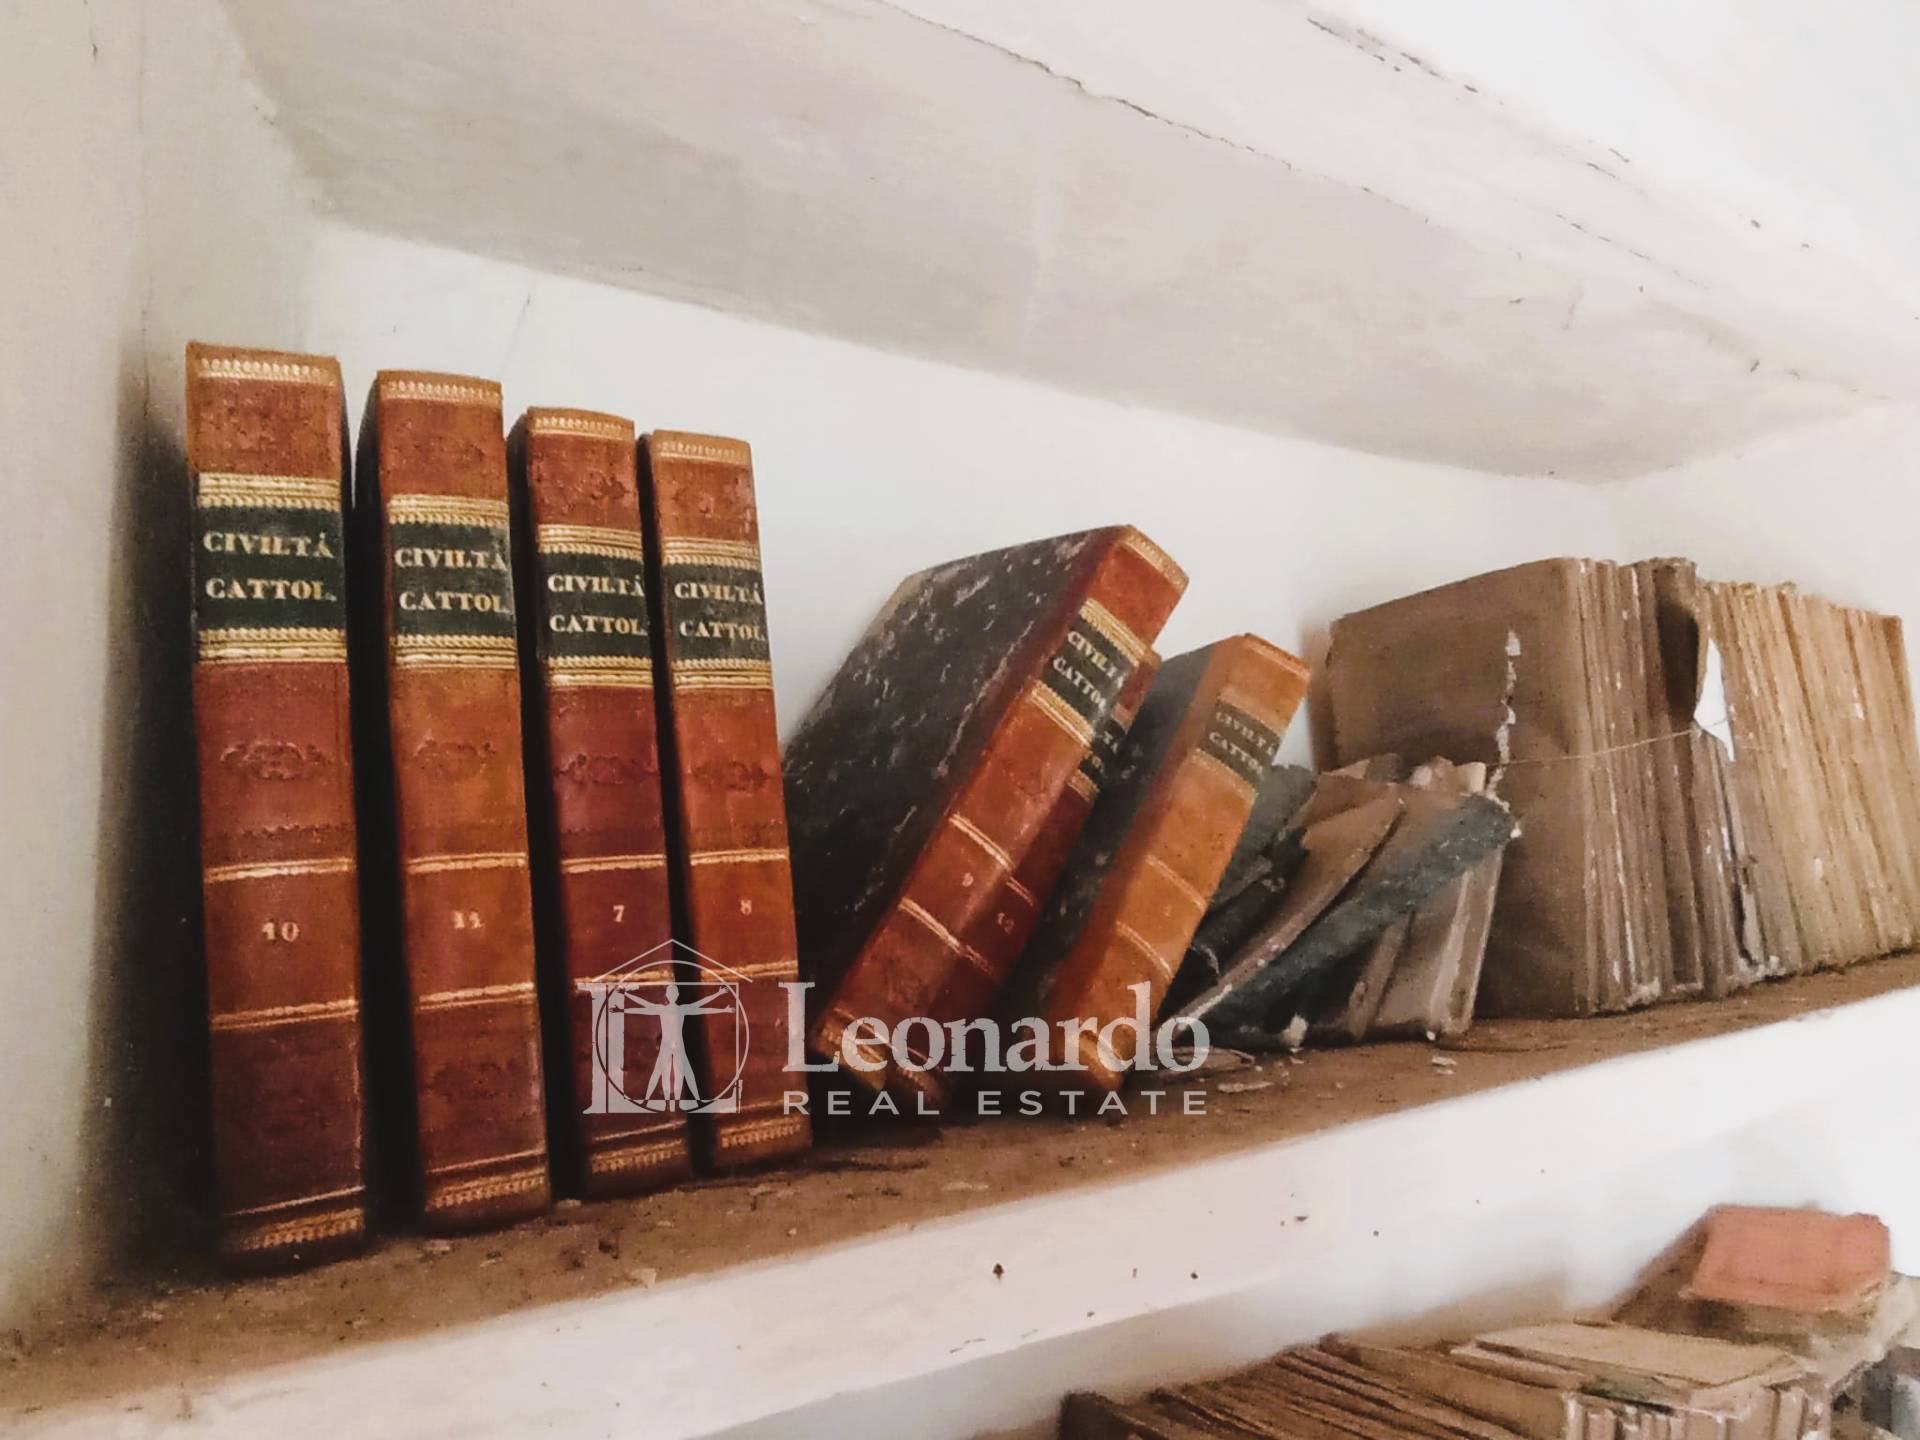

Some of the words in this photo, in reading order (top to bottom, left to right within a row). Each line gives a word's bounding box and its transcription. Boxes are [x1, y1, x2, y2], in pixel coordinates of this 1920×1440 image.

[612, 904, 626, 923] 7
[740, 899, 753, 916] 8
[453, 910, 485, 929] 11
[262, 920, 299, 941] 10
